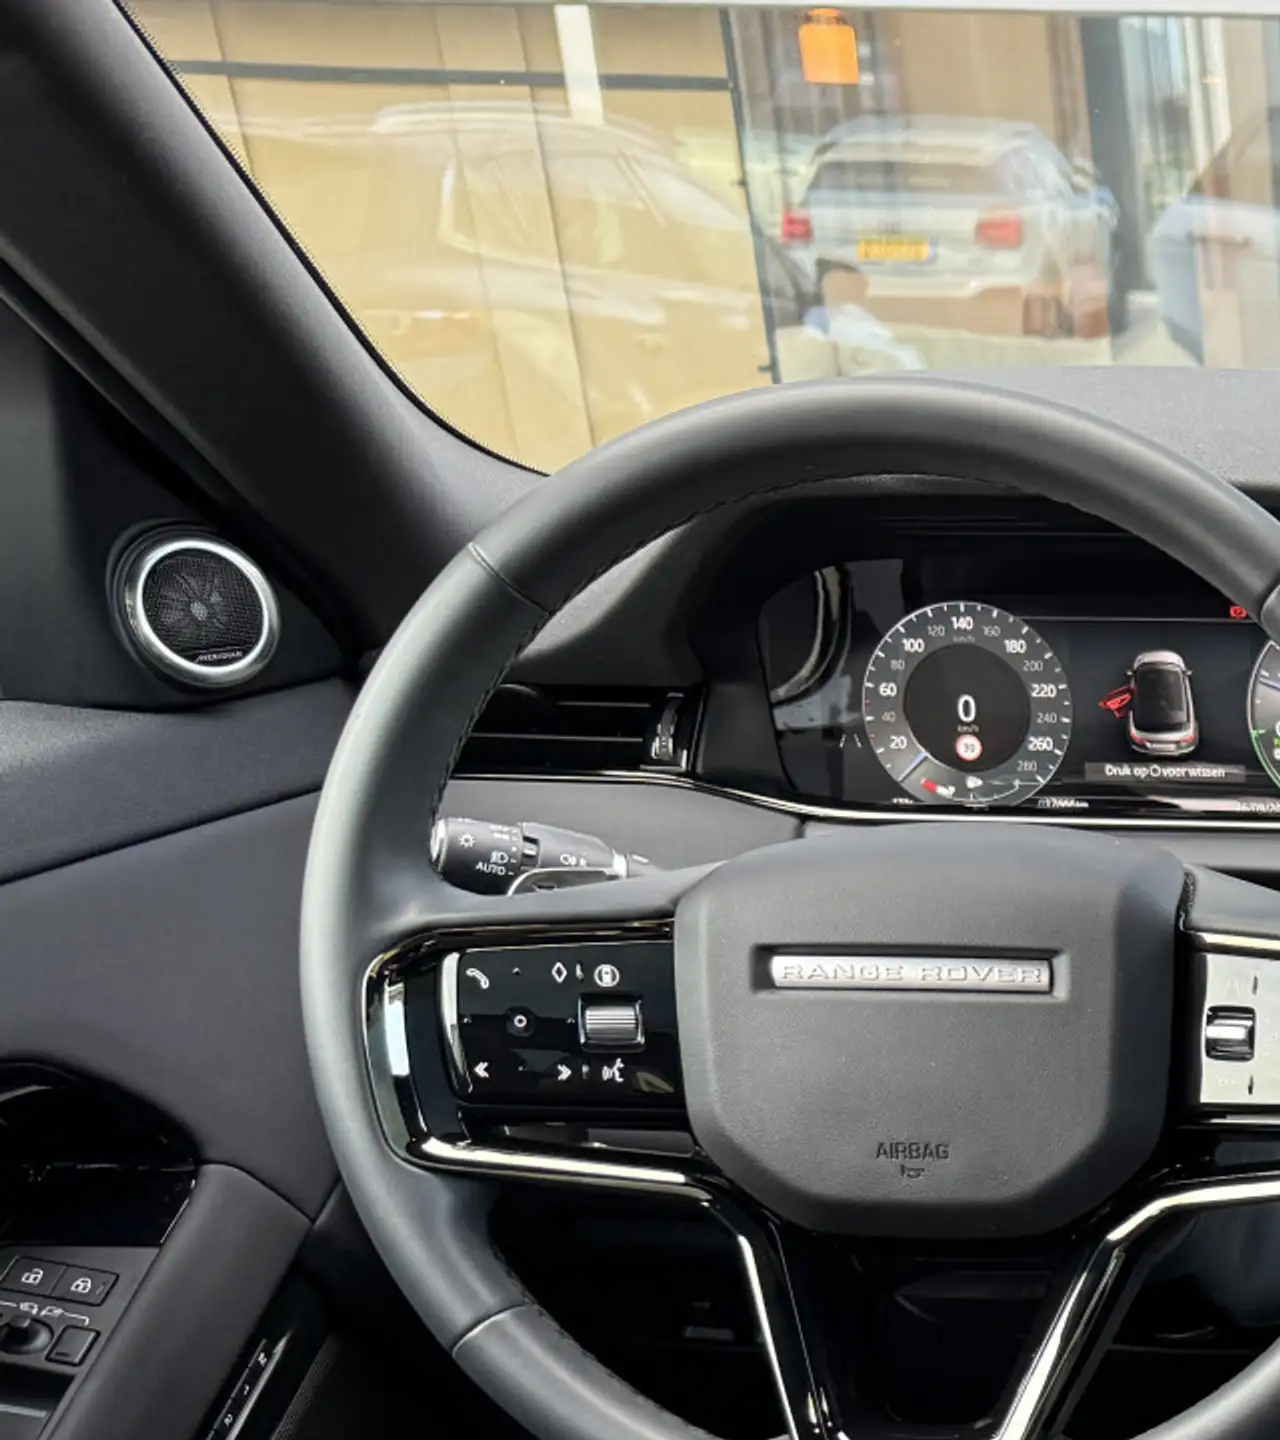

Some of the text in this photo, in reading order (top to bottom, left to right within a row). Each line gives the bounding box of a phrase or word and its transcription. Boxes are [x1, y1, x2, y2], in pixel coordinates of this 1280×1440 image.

[951, 616, 973, 630] 140
[927, 625, 945, 637] 120
[982, 625, 1000, 637] 160
[902, 638, 925, 653] 100
[1003, 638, 1027, 653] 180
[890, 659, 905, 671] 80
[1023, 660, 1043, 672] 200
[879, 682, 897, 697] 60
[1031, 683, 1057, 698] 220
[957, 694, 976, 723] 0
[882, 711, 896, 722] 40
[1037, 712, 1057, 724] 240
[889, 735, 907, 749] 20
[1027, 737, 1053, 751] 260
[1016, 760, 1038, 772] 280
[1104, 763, 1132, 776] Druk
[1133, 767, 1149, 779] op
[476, 861, 506, 876] AUTO
[782, 964, 1042, 984] RANGE ROVER
[876, 1142, 950, 1160] AIRBAG
